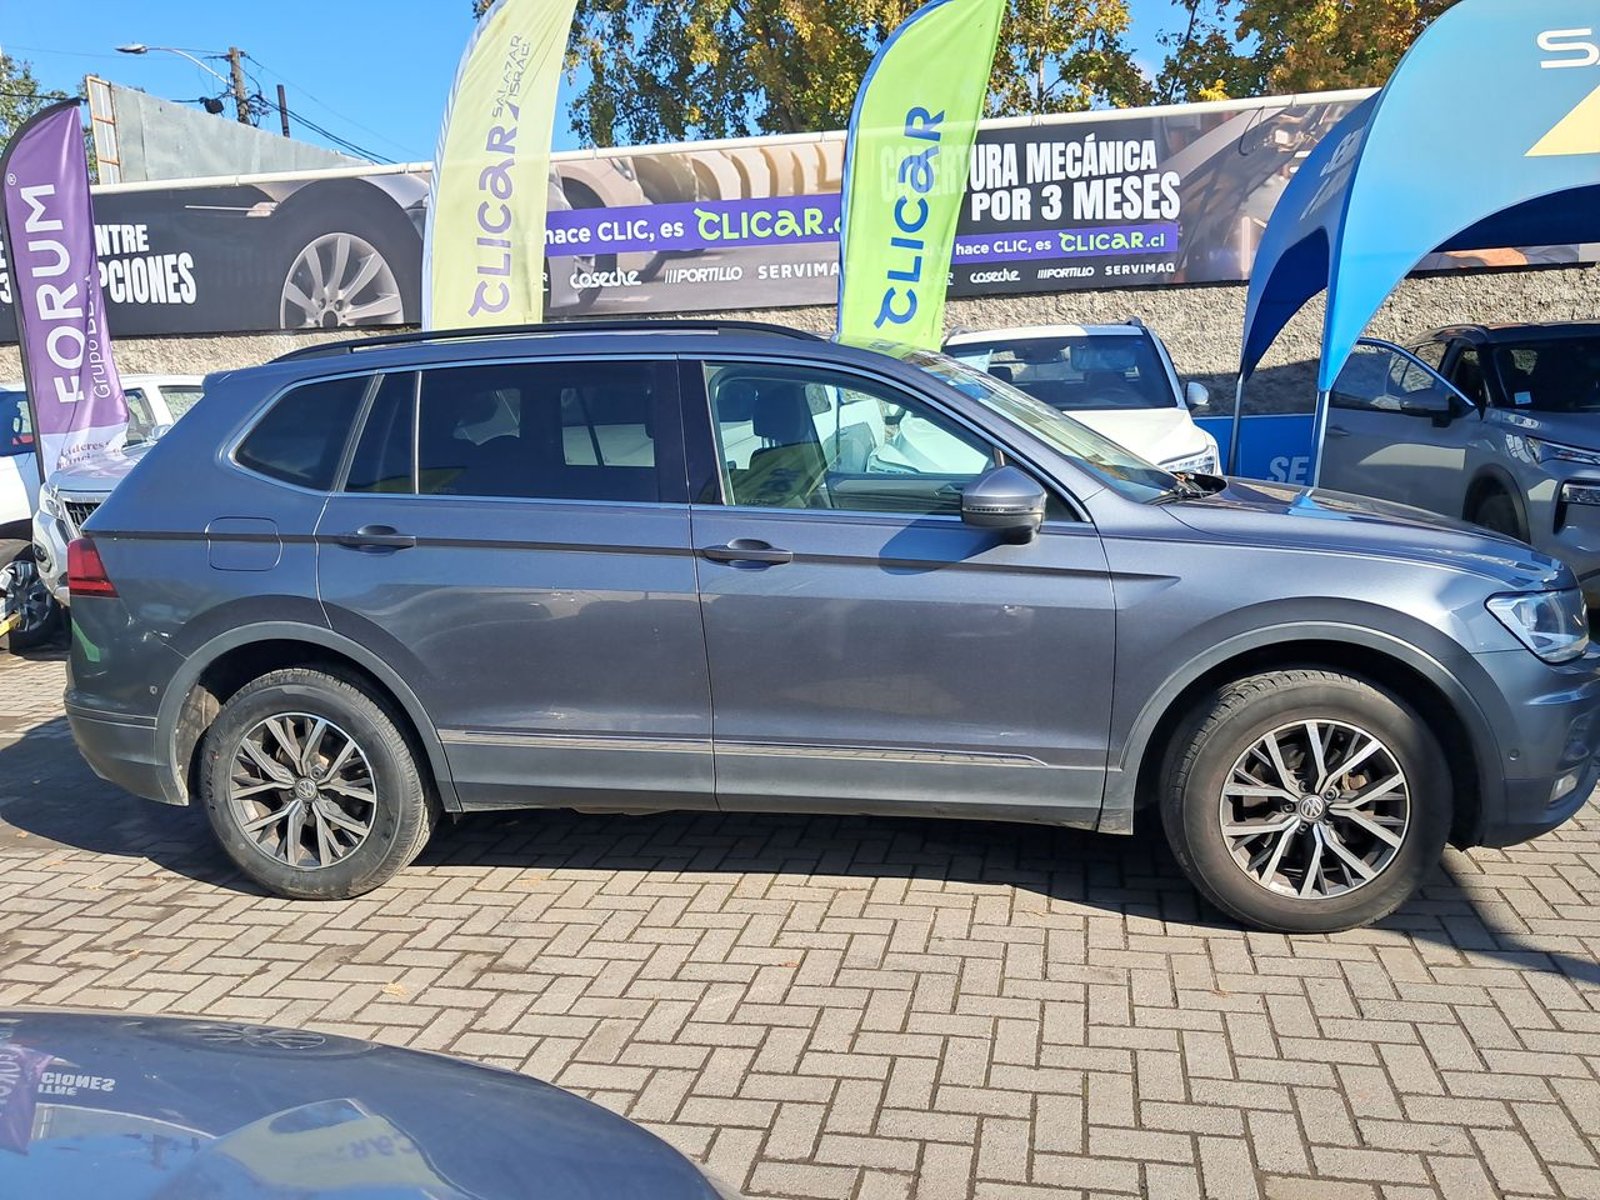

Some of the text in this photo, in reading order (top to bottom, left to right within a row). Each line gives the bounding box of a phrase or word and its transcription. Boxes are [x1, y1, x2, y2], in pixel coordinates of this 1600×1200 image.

[1536, 28, 1600, 69] S
[1026, 133, 1158, 200] MECÁNICA
[971, 170, 1181, 222] POR 3 MESES
[94, 224, 150, 257] NTRE
[597, 219, 656, 242] CLIC,
[659, 220, 685, 239] es
[955, 243, 989, 256] hace
[993, 239, 1032, 255] CLIC,
[1035, 240, 1052, 252] es
[97, 252, 197, 305] PCIONES
[757, 261, 840, 281] SERVIMA
[1104, 261, 1176, 277] SERVIMAQ
[20, 183, 85, 404] FORUM
[87, 340, 111, 399] Grupo
